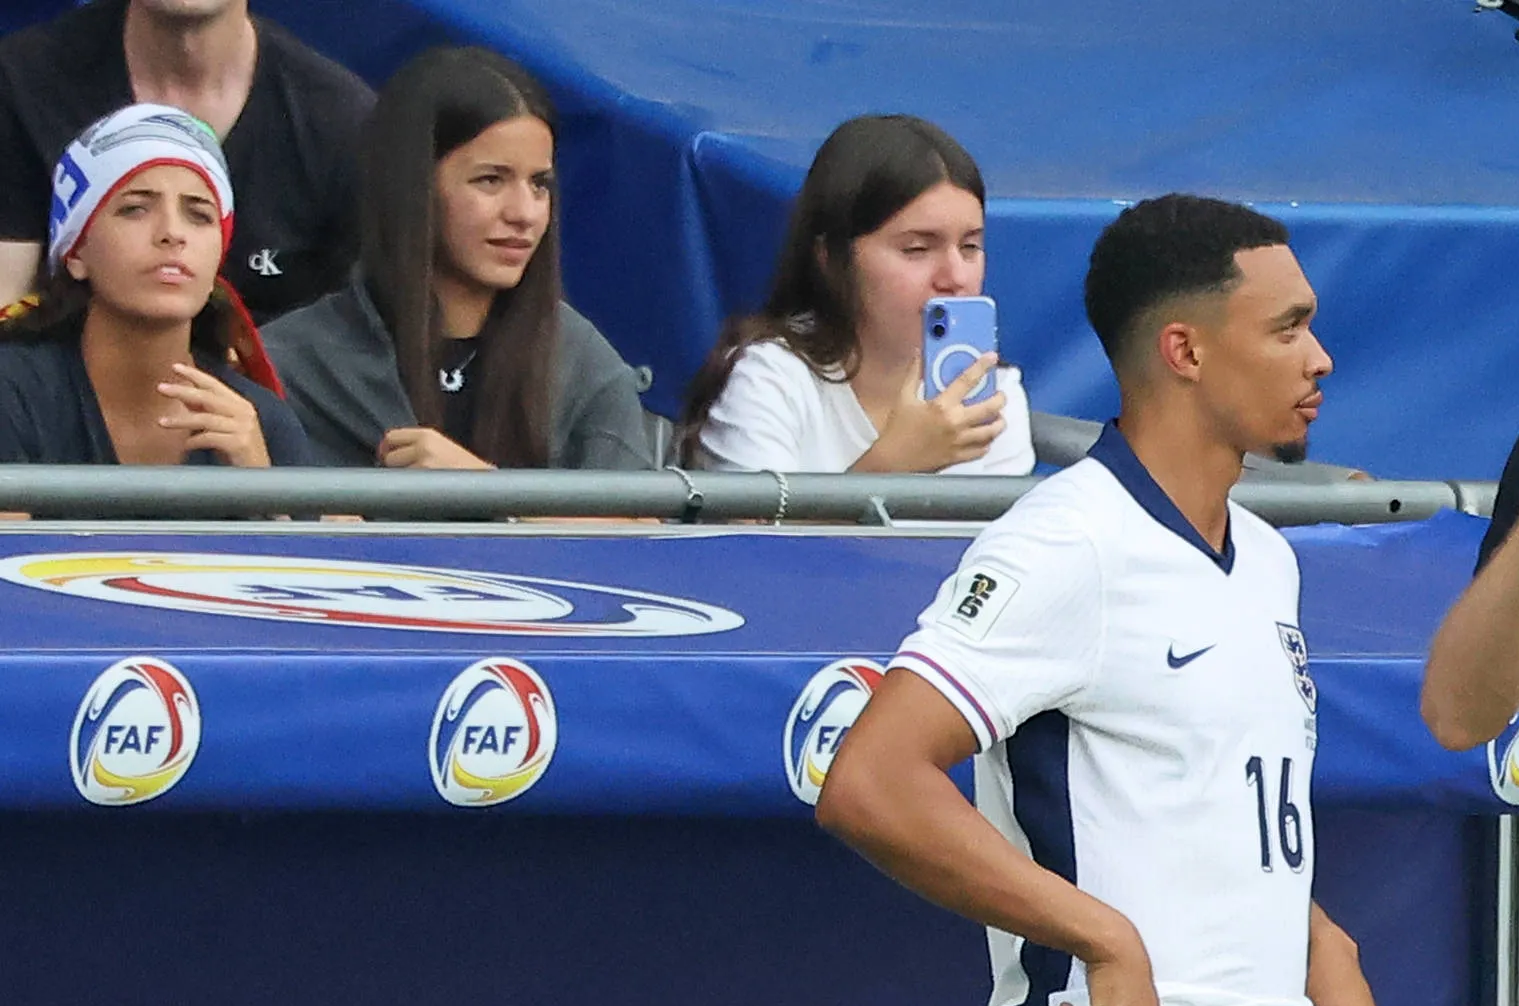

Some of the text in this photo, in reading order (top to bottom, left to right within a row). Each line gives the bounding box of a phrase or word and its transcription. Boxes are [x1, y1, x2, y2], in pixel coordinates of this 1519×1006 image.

[103, 725, 165, 755] FAF
[461, 725, 524, 755] FAF
[1245, 756, 1306, 874] 16
